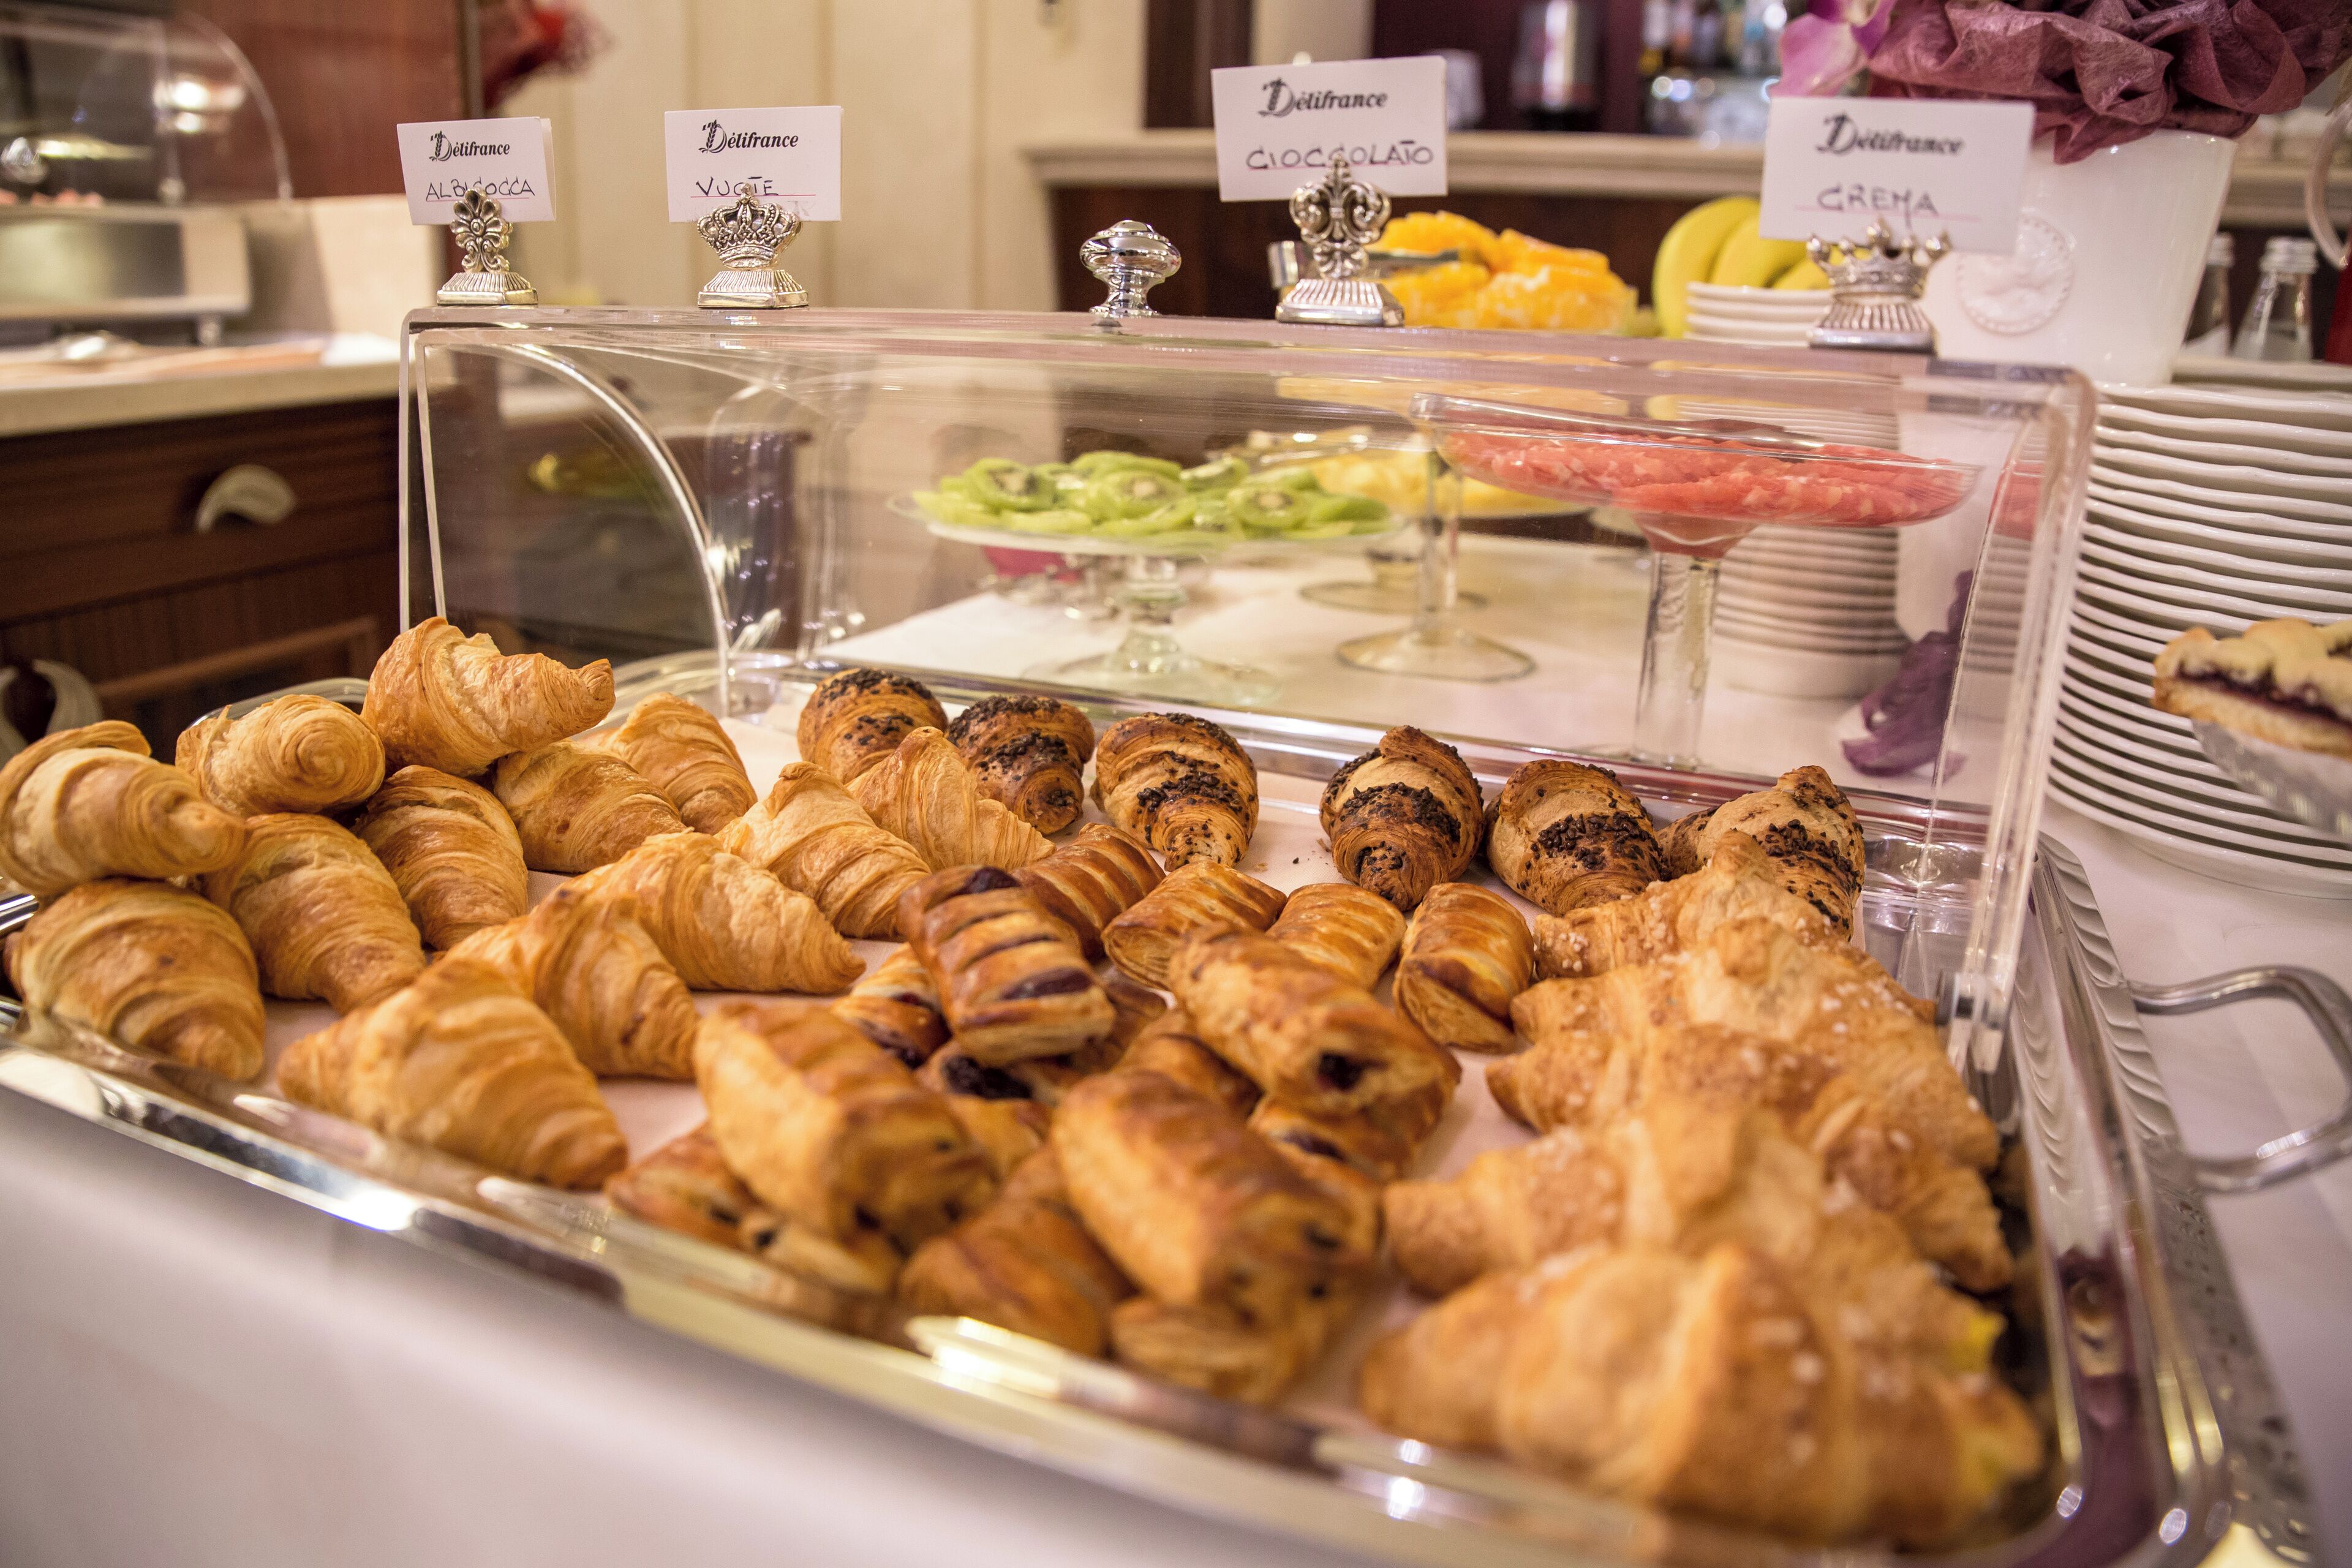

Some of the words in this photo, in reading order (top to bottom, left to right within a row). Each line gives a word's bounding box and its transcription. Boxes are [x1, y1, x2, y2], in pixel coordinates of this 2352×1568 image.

[1259, 77, 1388, 117] Délifrance
[429, 130, 510, 162] Délifrance
[698, 119, 799, 154] Délifrance
[1246, 140, 1434, 169] CIOCCOLATO
[1817, 184, 1939, 228] CREMA
